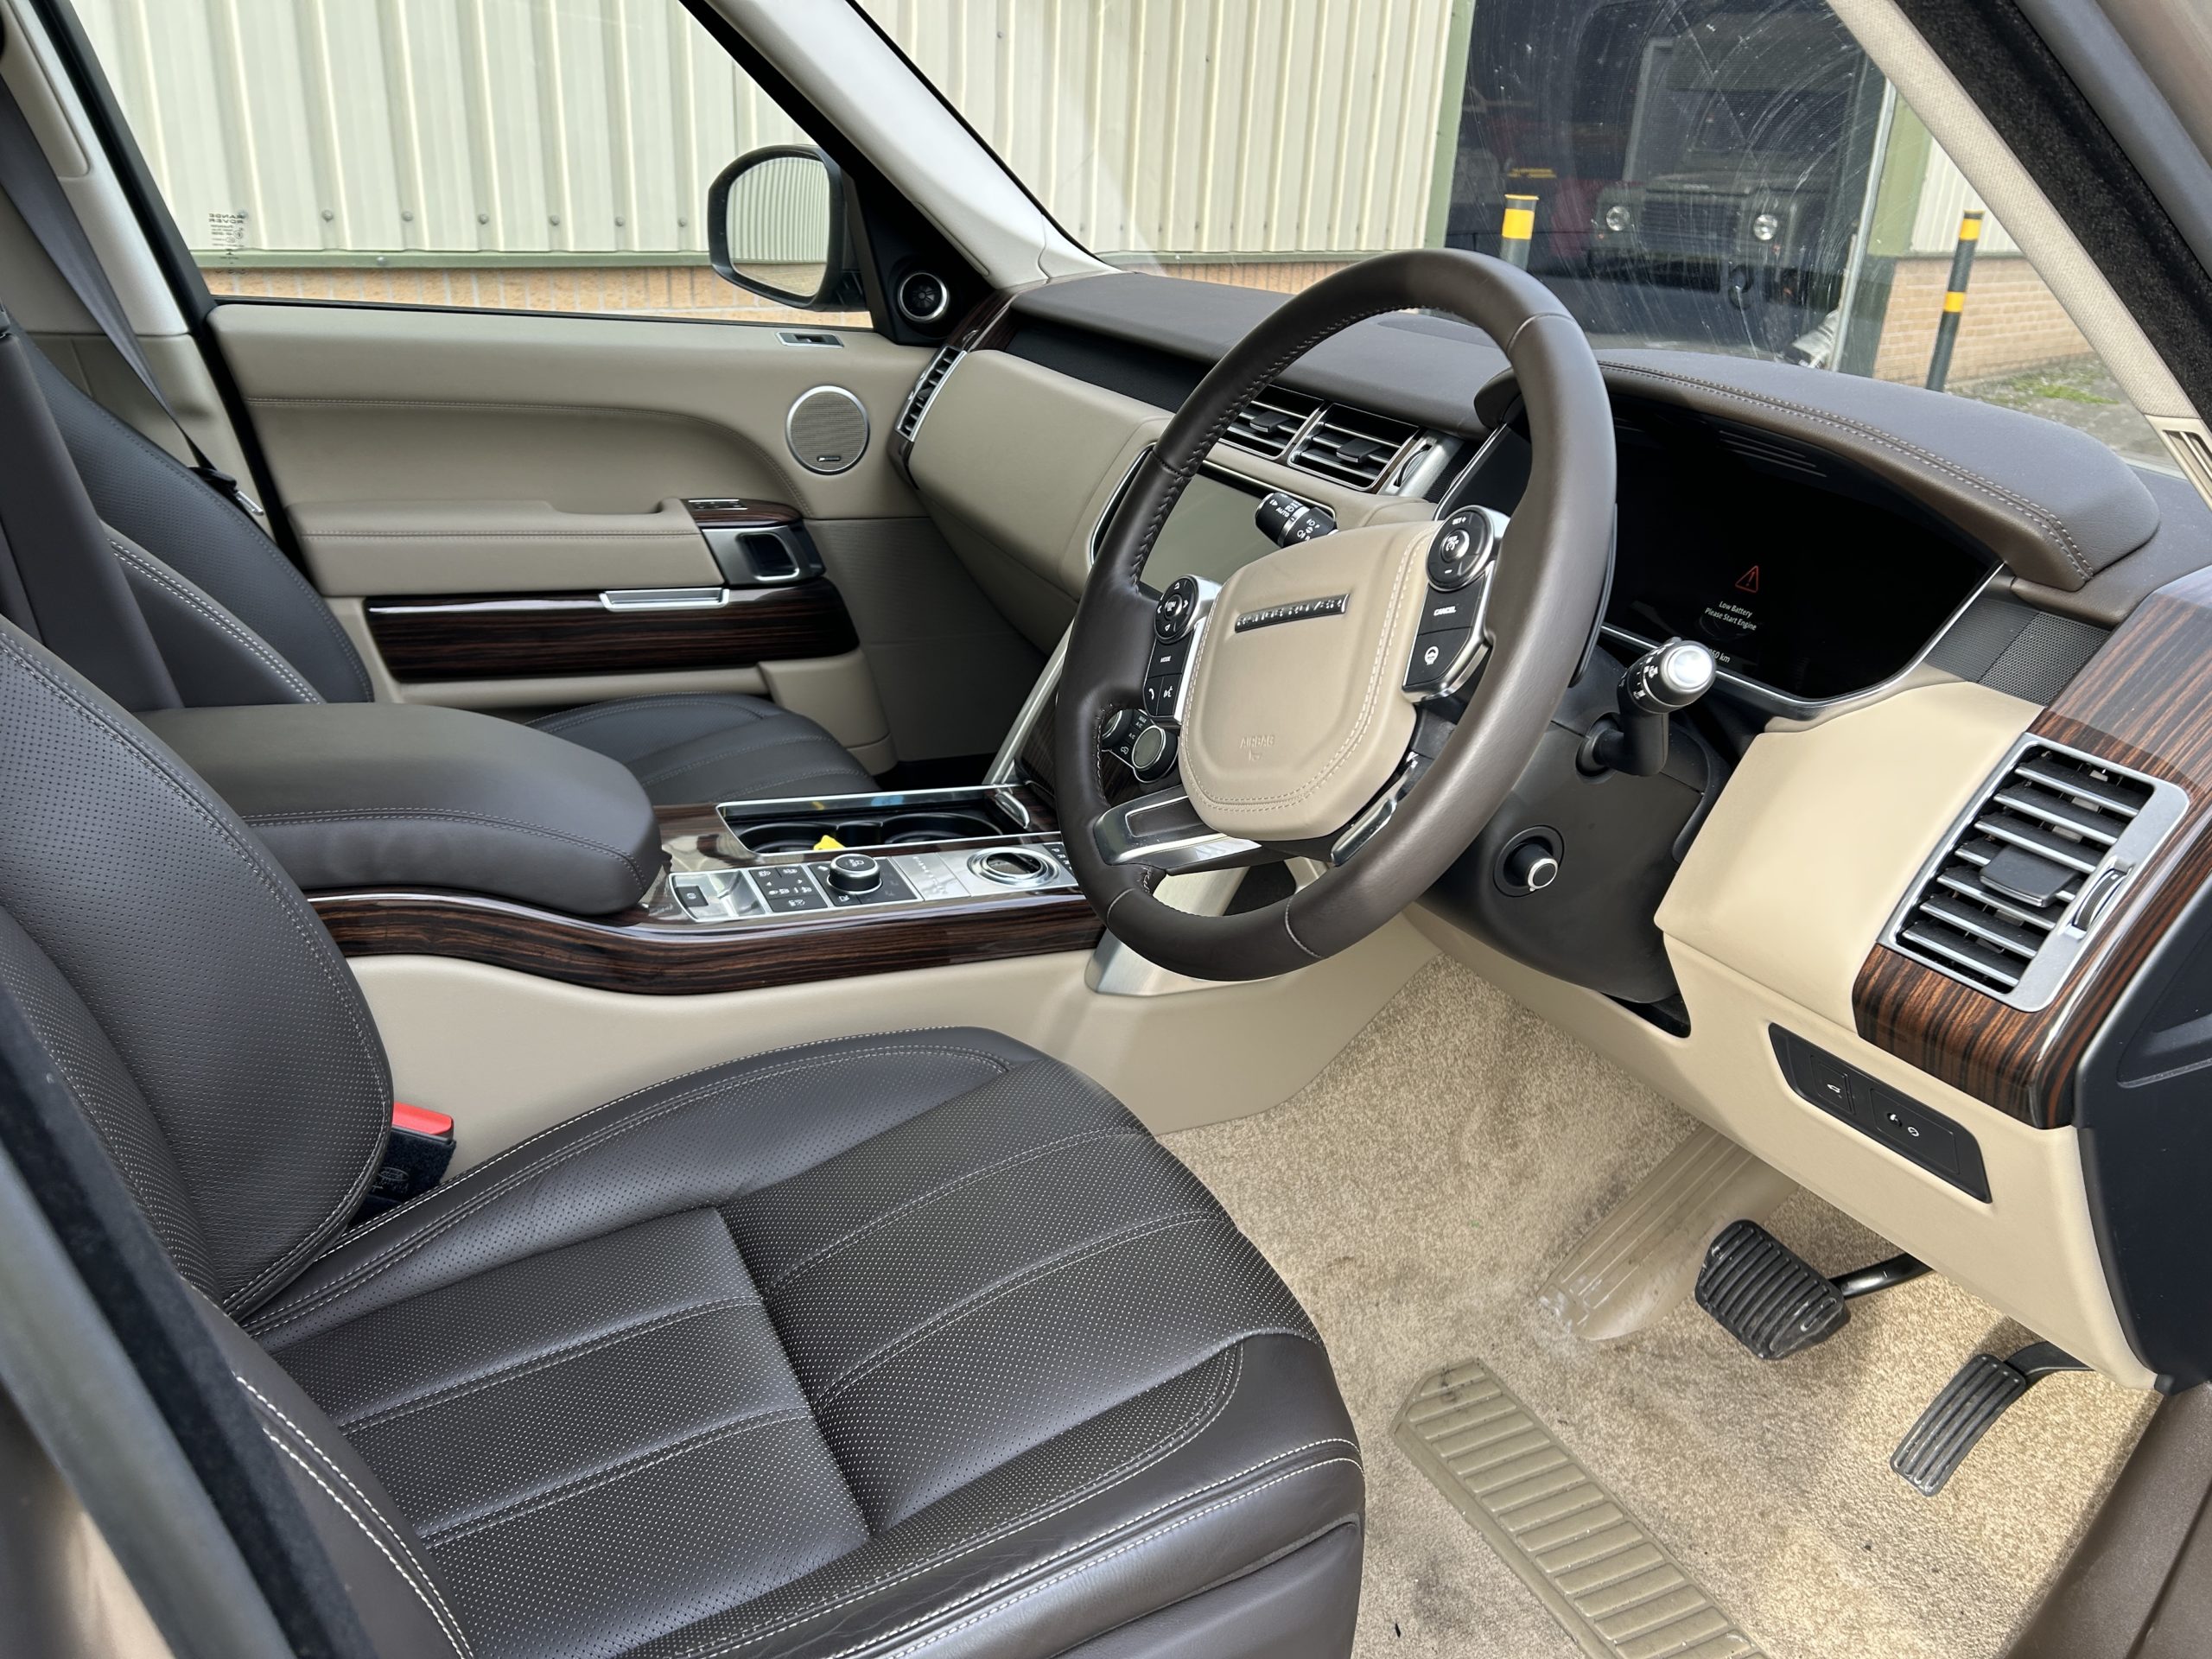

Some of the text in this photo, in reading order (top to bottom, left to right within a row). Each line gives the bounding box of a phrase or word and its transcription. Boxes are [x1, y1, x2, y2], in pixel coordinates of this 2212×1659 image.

[1275, 506, 1290, 518] AUTO
[1433, 606, 1457, 616] CANCEL
[1719, 601, 1753, 619] Low Battery
[1705, 607, 1758, 631] Please Start Engine
[1719, 652, 1731, 663] km
[1238, 734, 1275, 749] AIRBAG
